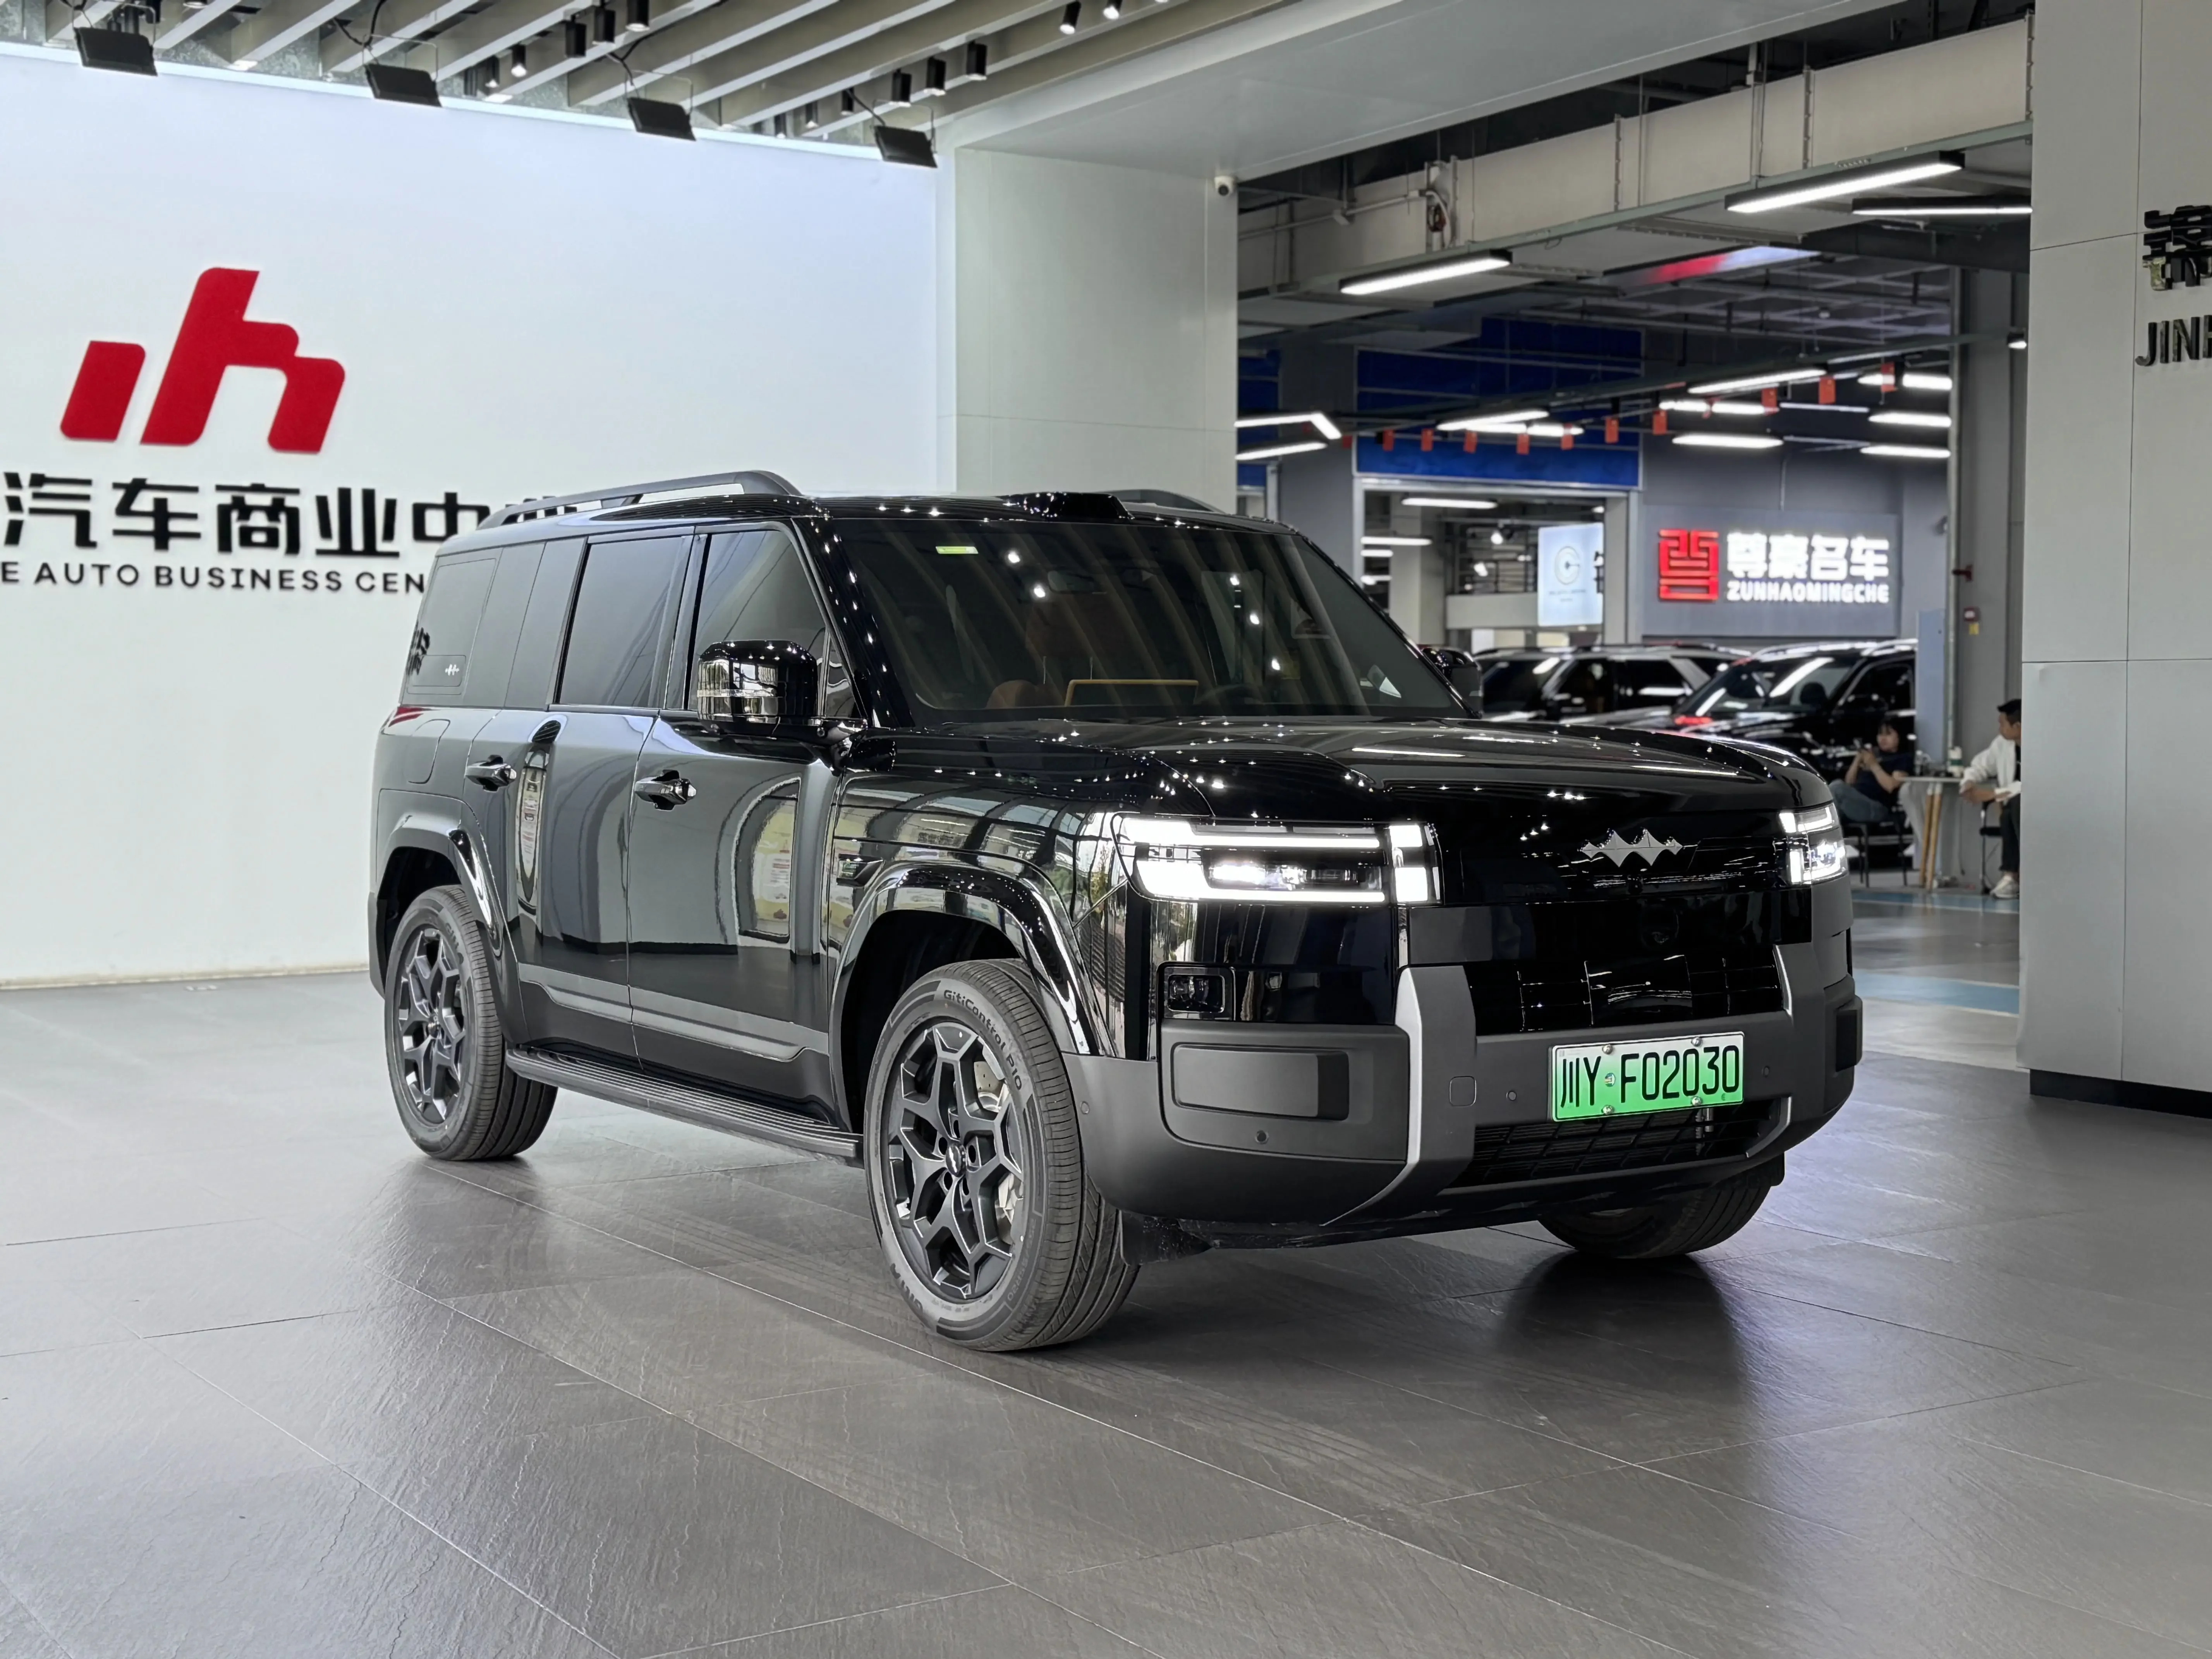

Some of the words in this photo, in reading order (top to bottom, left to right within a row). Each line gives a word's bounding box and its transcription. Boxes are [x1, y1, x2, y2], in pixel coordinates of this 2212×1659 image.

[3, 472, 577, 558] 汽车商业中
[34, 562, 139, 586] AUTO
[156, 565, 342, 591] BUSINESS
[1726, 579, 1889, 603] ZUNHAOMINGCHE
[944, 989, 1006, 1050] GitiControl
[1561, 1056, 1601, 1108] 川Y
[1620, 1045, 1740, 1103] F02030
